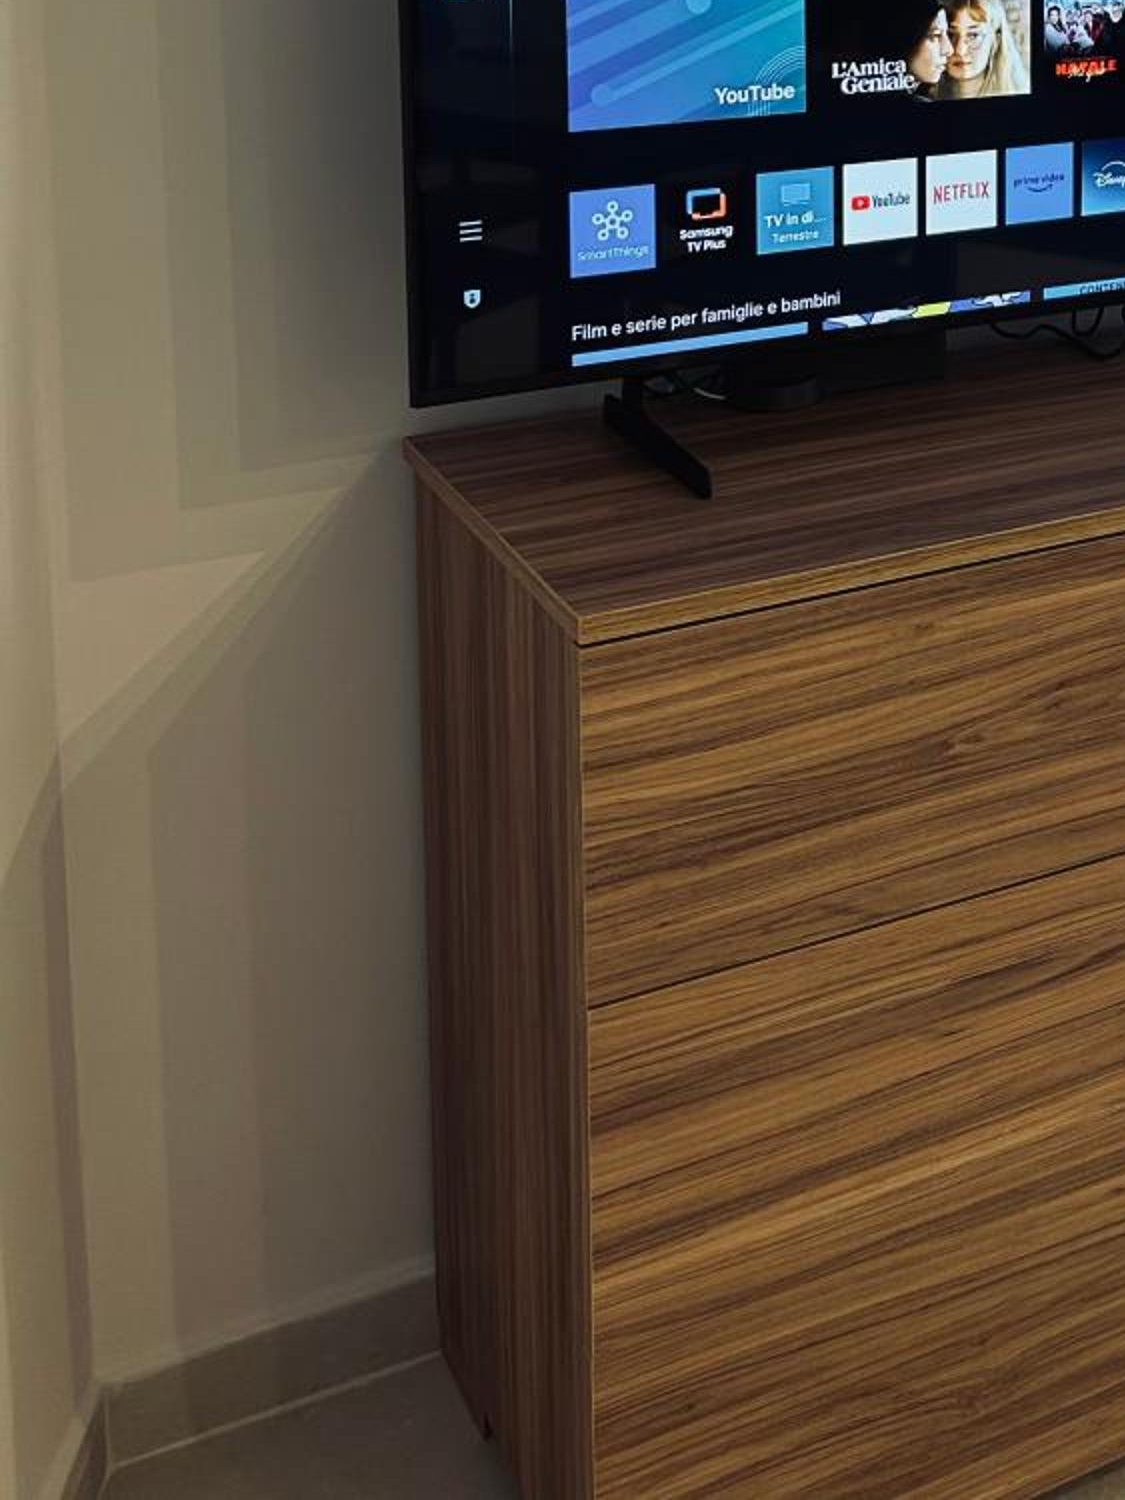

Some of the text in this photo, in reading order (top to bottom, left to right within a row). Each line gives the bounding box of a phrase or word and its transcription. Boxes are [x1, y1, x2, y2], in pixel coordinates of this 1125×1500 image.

[832, 58, 907, 79] L'Amica
[840, 72, 916, 96] Geniale
[714, 83, 796, 106] YouTube
[1013, 172, 1065, 188] prime video
[872, 192, 911, 208] YouTube
[932, 181, 990, 204] NETFLIX
[763, 214, 782, 228] TV
[786, 213, 799, 225] in
[679, 225, 734, 241] Samsung
[770, 230, 819, 244] Terrestre
[576, 245, 649, 261] SmartThings
[686, 238, 727, 253] TV Plus
[571, 289, 841, 341] Film e serie per famiglie e bambini
